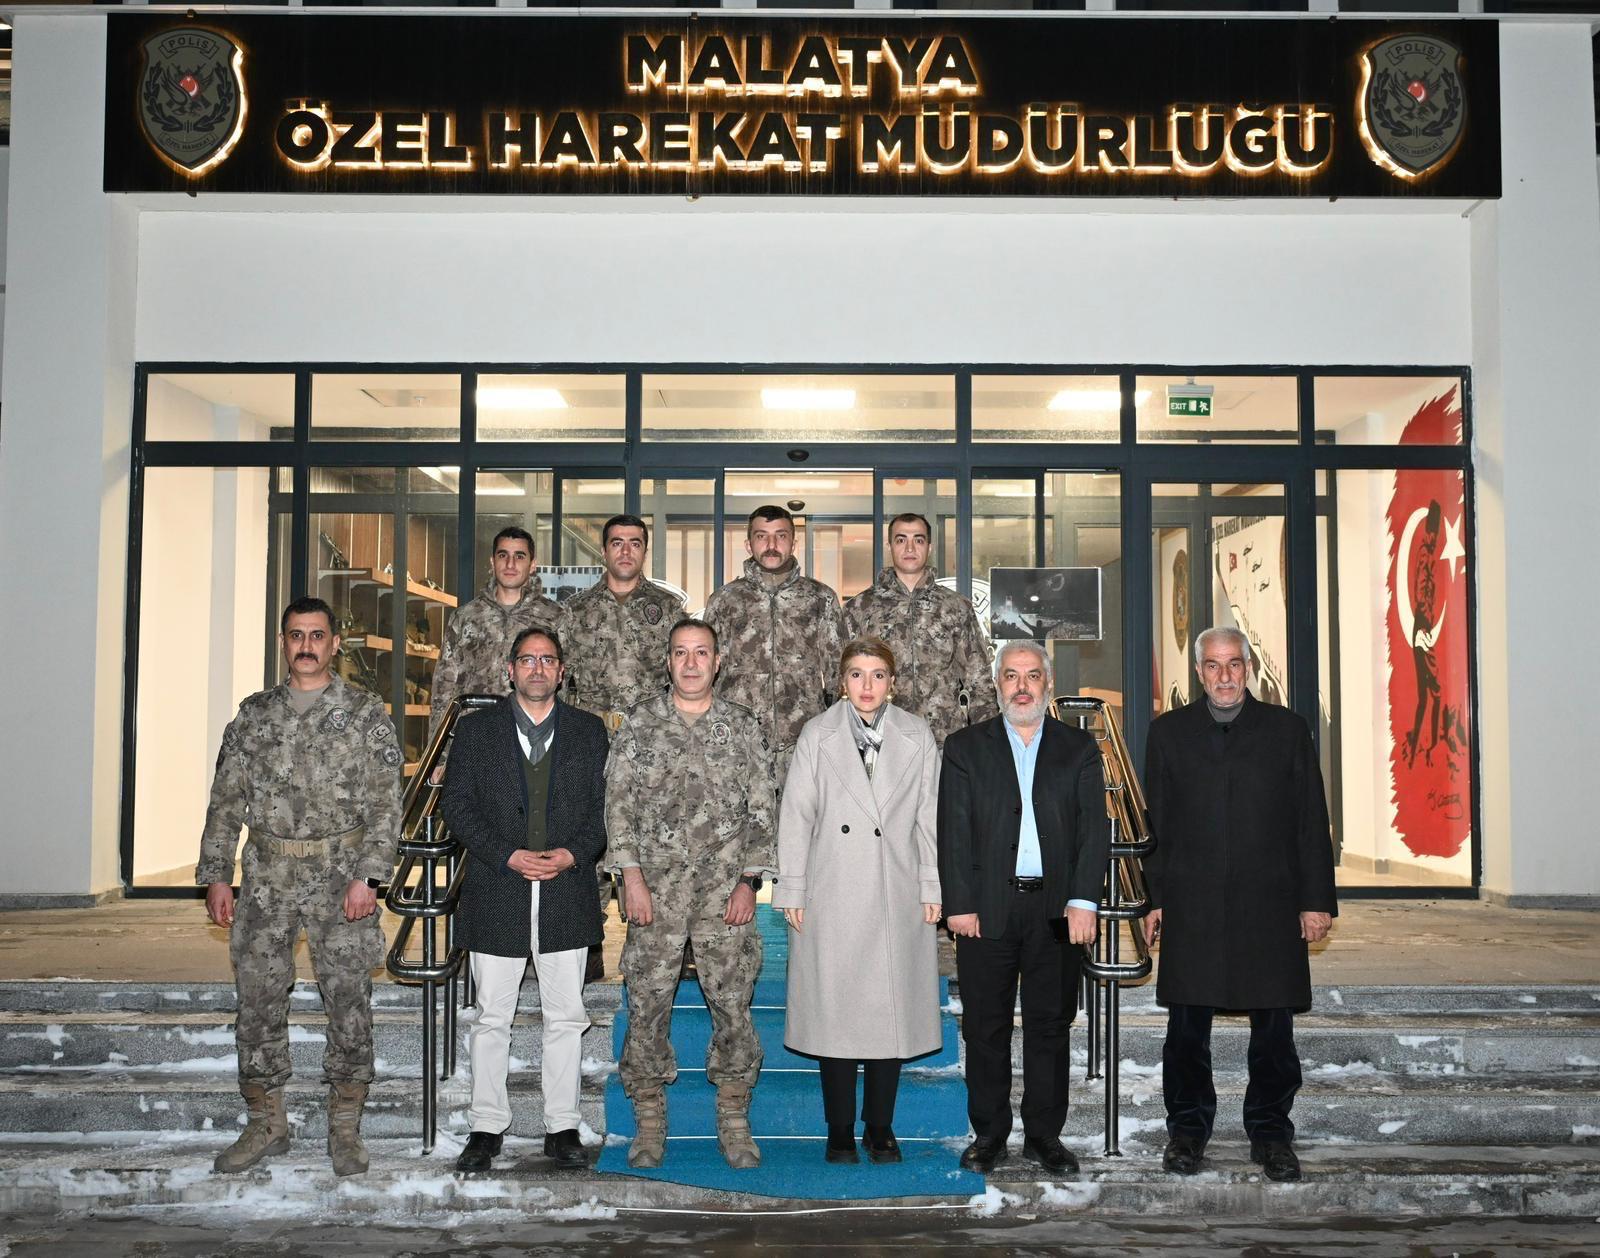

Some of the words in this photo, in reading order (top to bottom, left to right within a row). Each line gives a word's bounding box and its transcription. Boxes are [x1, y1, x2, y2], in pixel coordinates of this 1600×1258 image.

[626, 34, 980, 90] MALATYA
[276, 99, 468, 165] ÖZEL
[488, 111, 842, 166] HAREKAT
[861, 102, 1333, 168] MÜDÜRLÜĞÜ
[1170, 402, 1187, 410] EXIT
